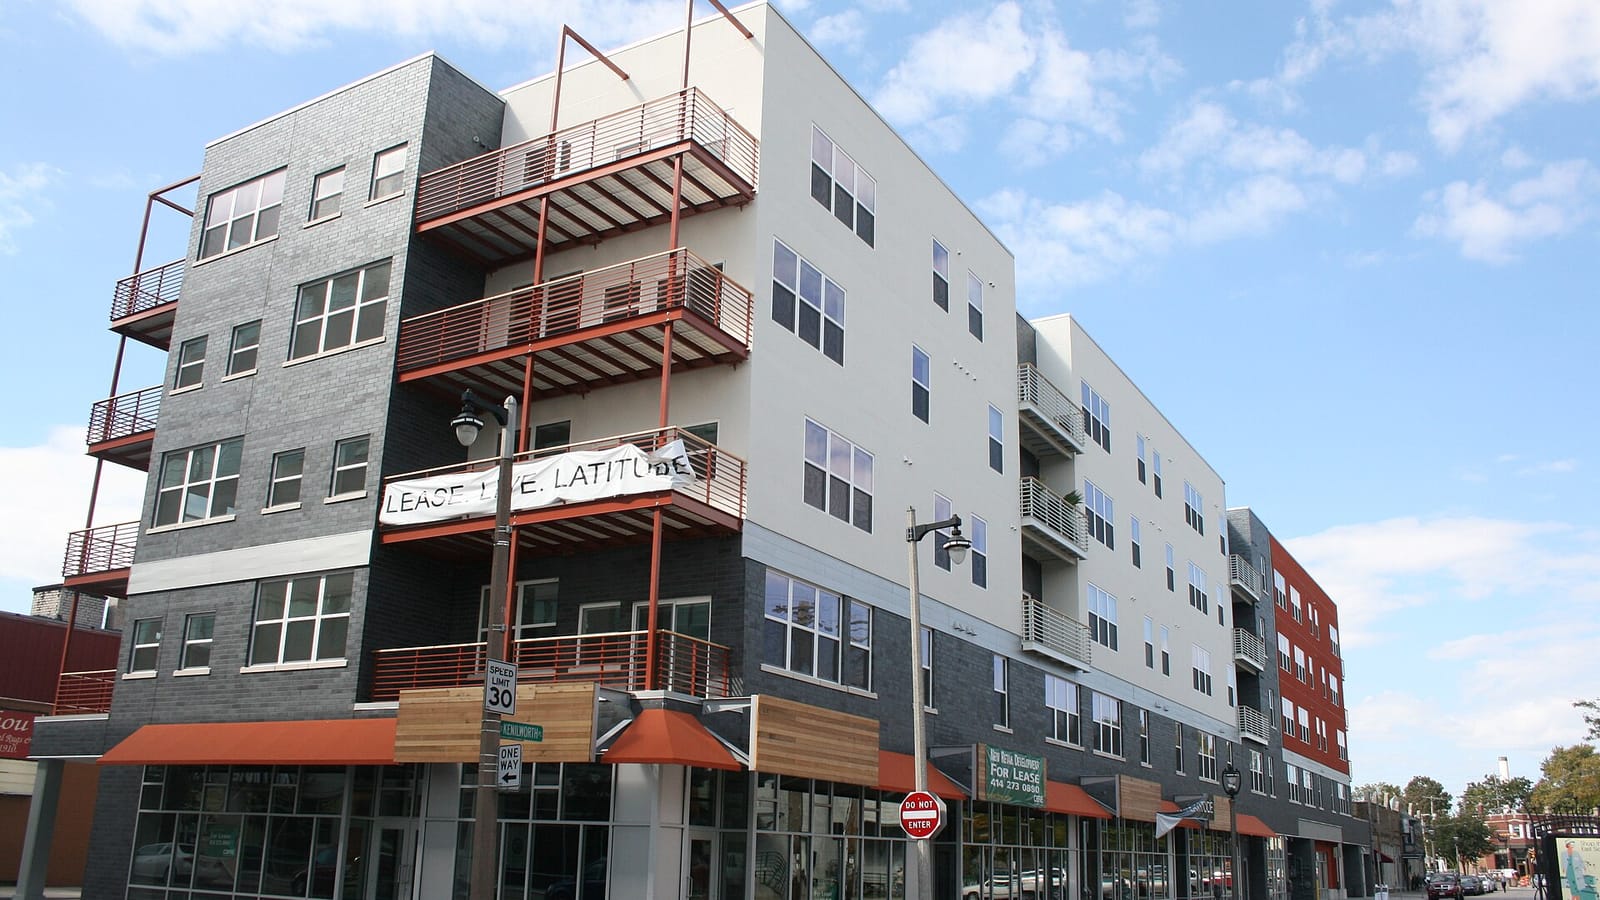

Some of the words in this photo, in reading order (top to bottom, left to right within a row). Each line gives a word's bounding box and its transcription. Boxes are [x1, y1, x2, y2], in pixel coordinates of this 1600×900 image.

[554, 455, 691, 489] LATITUDE
[489, 665, 514, 678] SPEED
[491, 677, 511, 688] LIMIT
[488, 686, 513, 709] 30
[0, 717, 29, 732] ou
[502, 722, 539, 739] KENILWORTH
[501, 747, 519, 759] ONE
[990, 748, 1001, 763] NEW
[500, 759, 519, 770] WAY
[990, 763, 1009, 778] FOR
[1013, 767, 1040, 785] LEASE
[990, 778, 1004, 788] 414
[1006, 780, 1020, 791] 273
[905, 801, 916, 809] DO
[918, 800, 933, 808] NOT
[908, 820, 931, 829] ENTER
